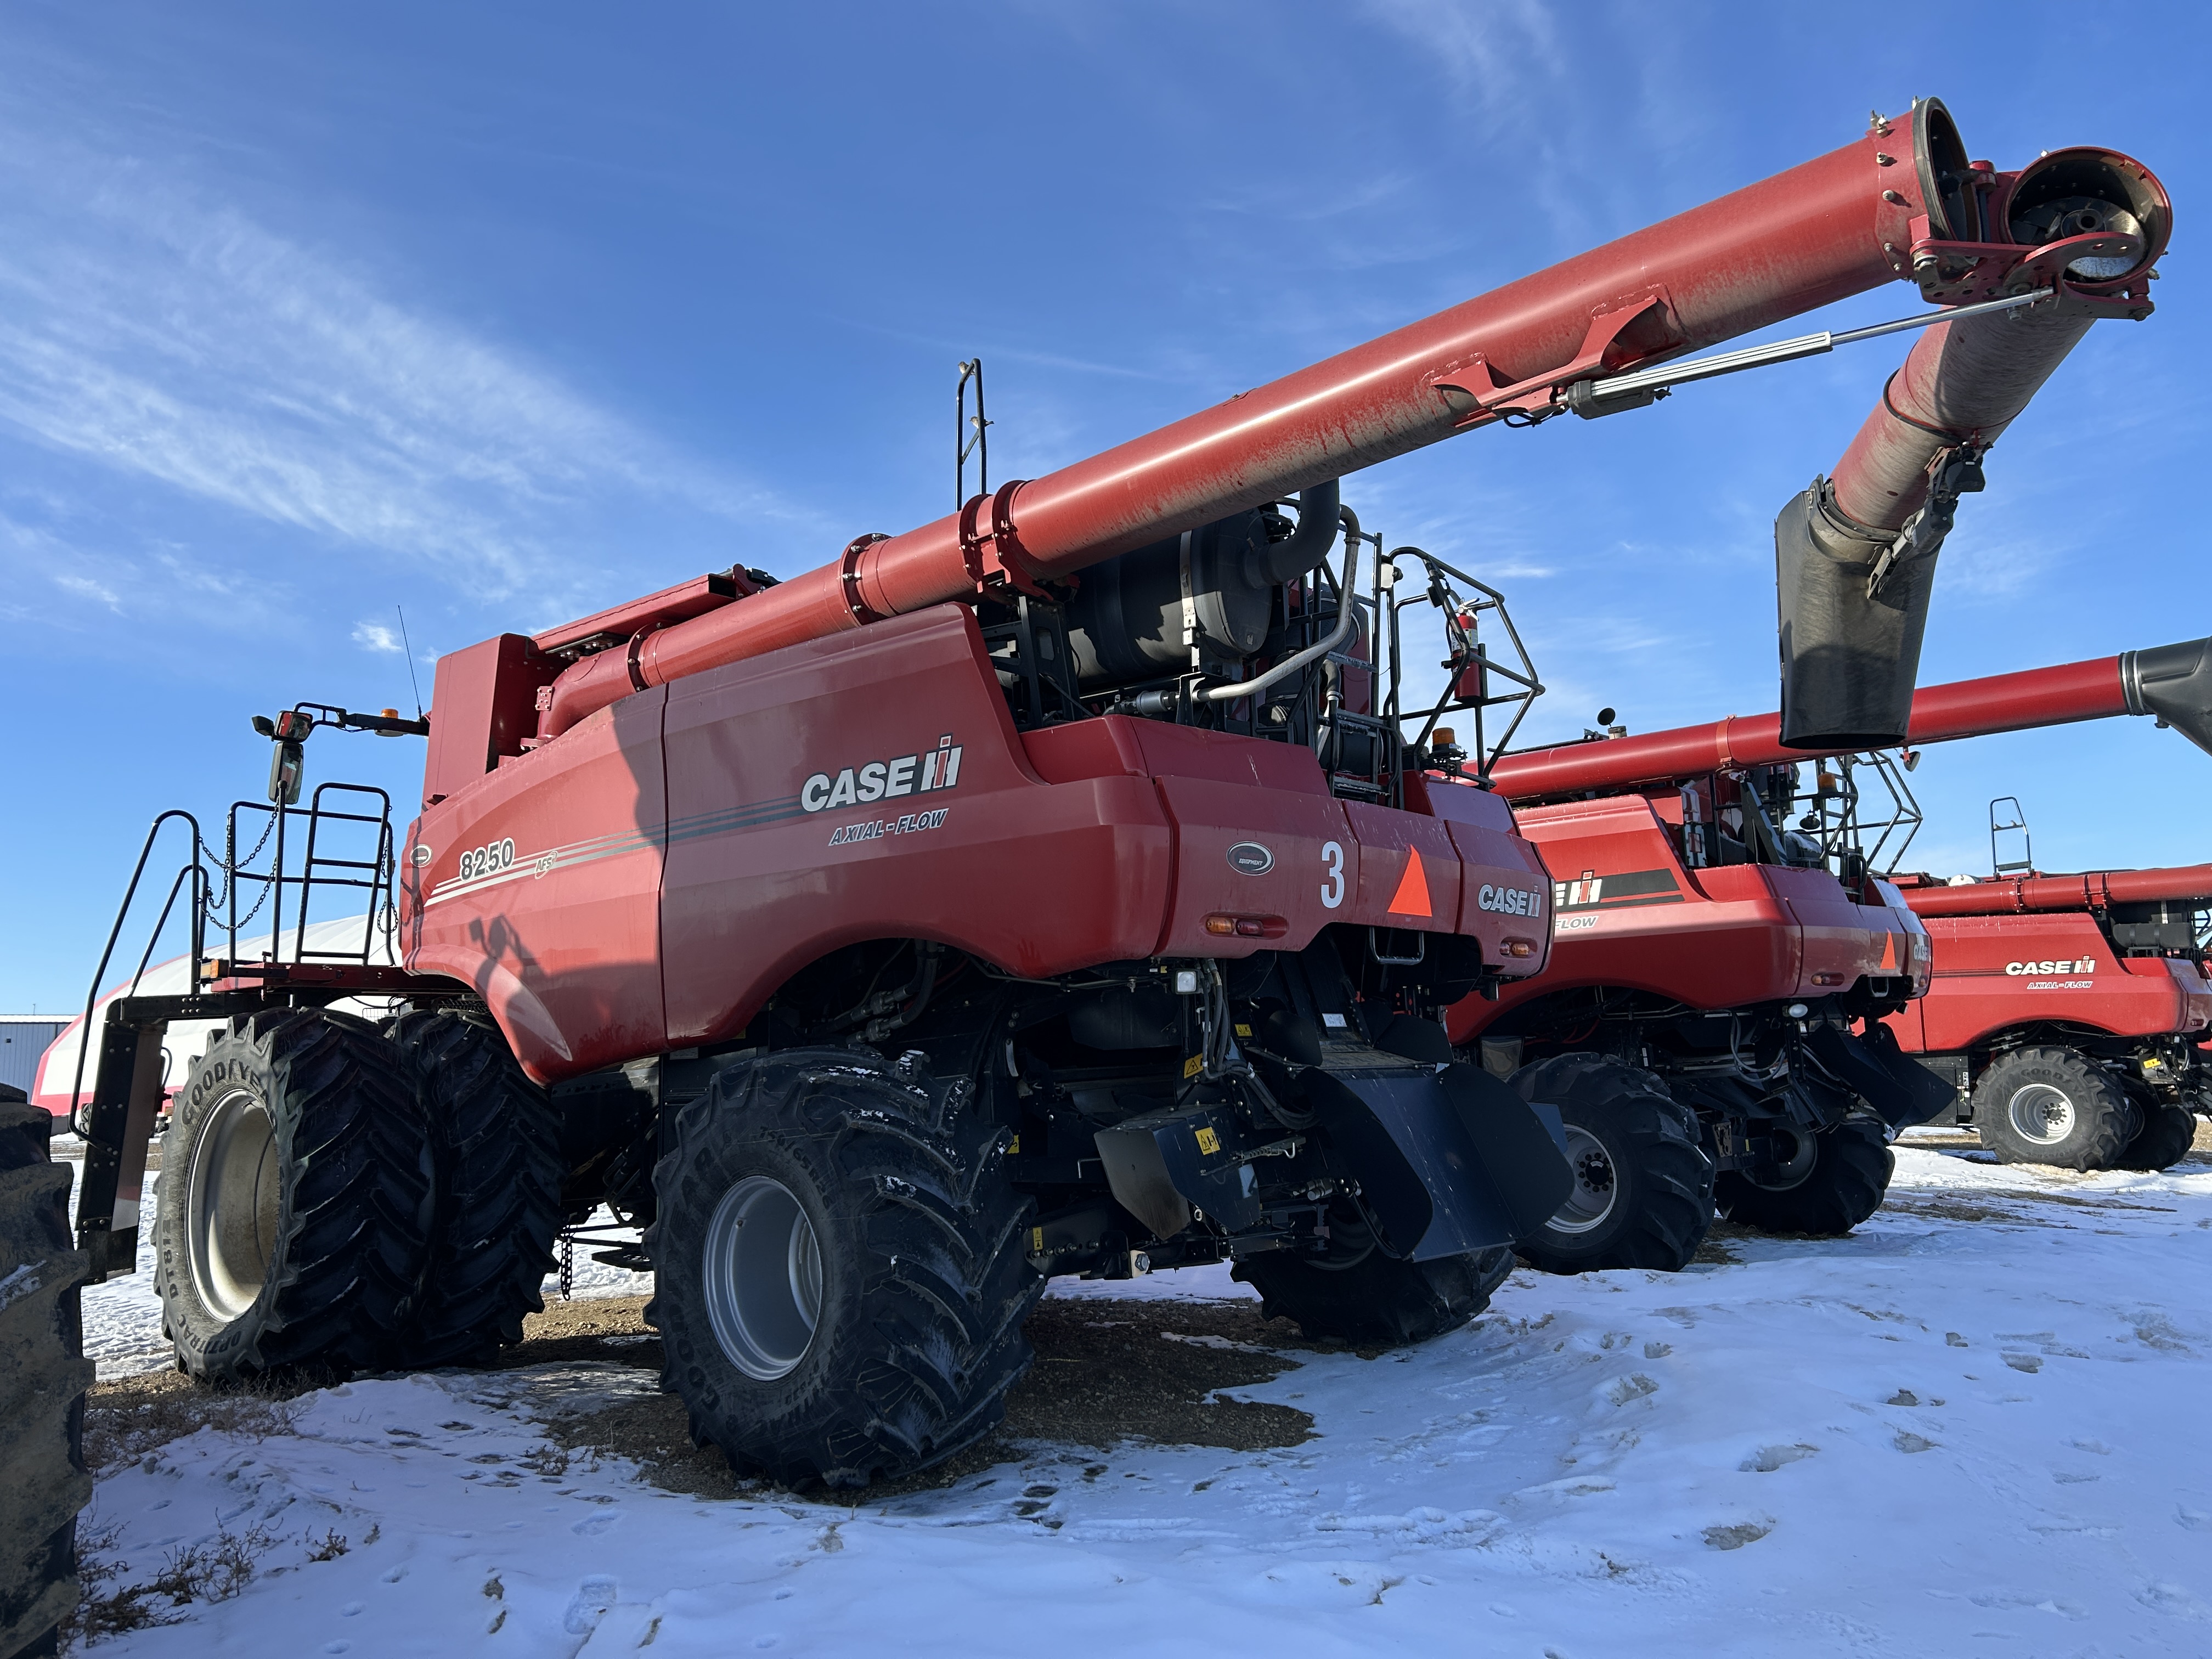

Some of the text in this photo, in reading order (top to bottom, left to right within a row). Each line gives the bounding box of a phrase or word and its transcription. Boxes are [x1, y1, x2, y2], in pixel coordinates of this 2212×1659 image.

[801, 735, 962, 812] CASE IH
[828, 808, 949, 846] AXIAL-FLOW
[460, 838, 515, 882] 8250
[535, 856, 552, 873] AFS
[1321, 841, 1344, 908] 3
[1479, 884, 1527, 915] CASE
[1527, 885, 1541, 917] IH
[2005, 955, 2096, 975] CASE IH
[2027, 981, 2093, 990] AXIAL-FLOW
